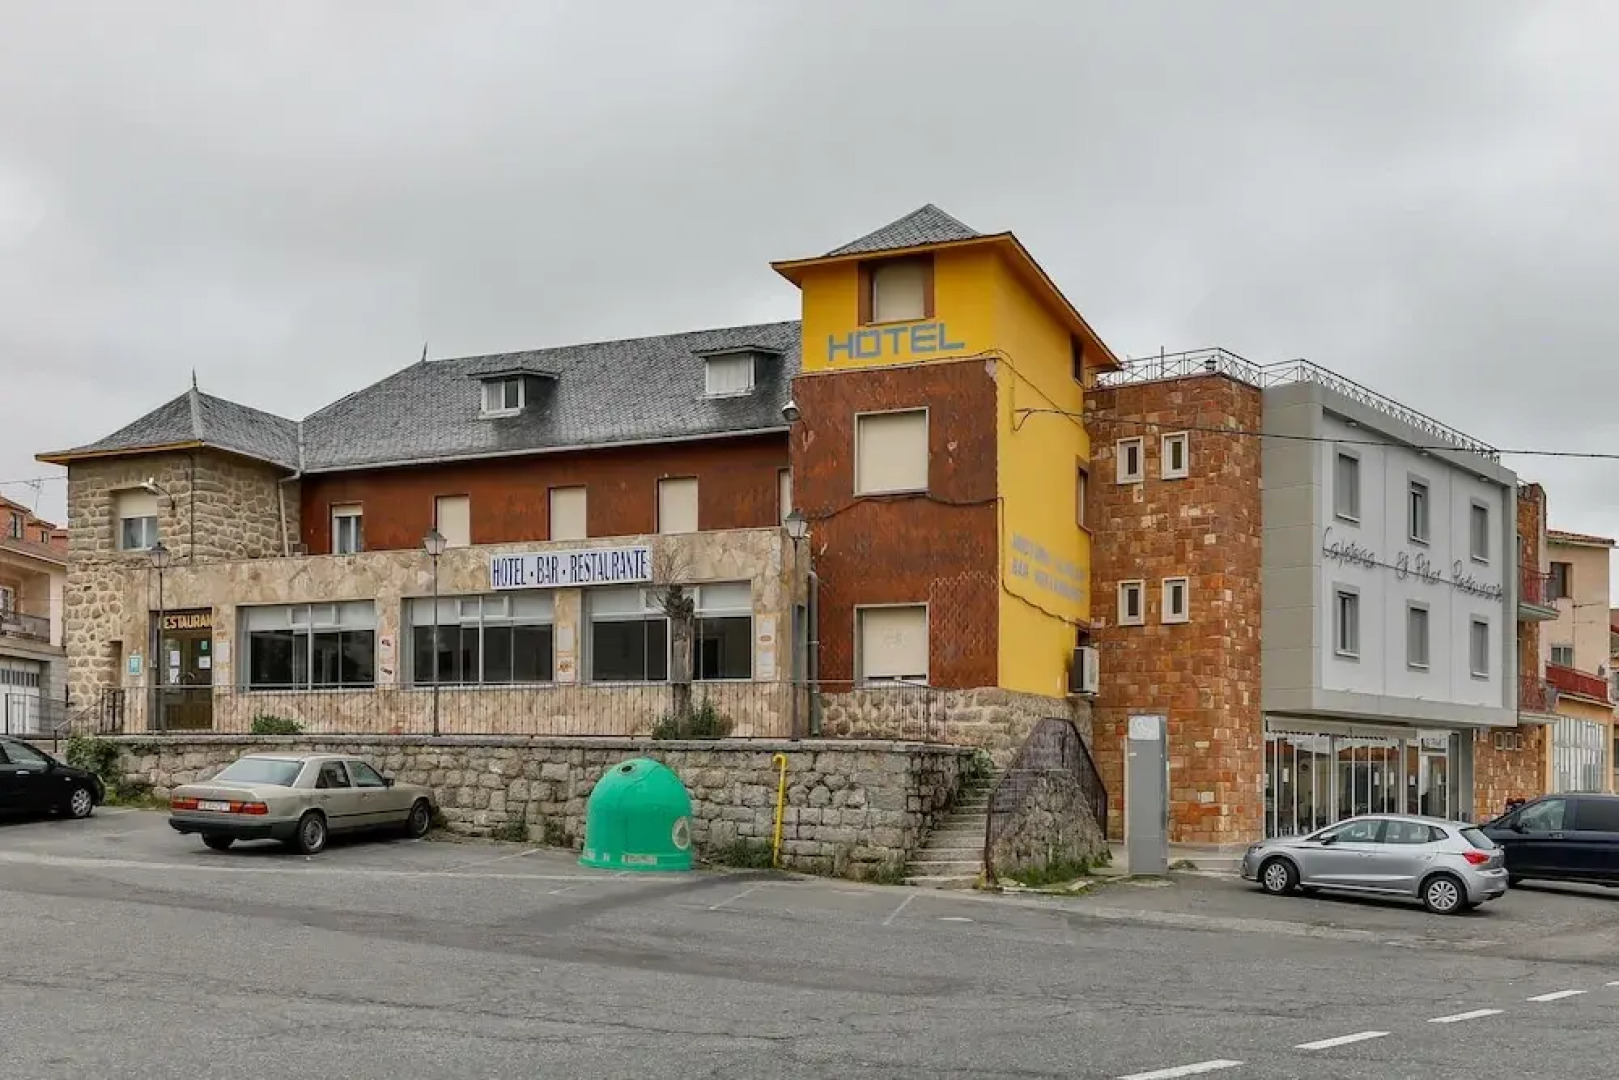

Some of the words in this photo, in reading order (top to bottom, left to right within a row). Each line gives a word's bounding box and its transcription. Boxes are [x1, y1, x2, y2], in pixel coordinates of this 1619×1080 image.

[828, 322, 965, 362] HOTEL
[493, 558, 527, 587] HOTEL
[537, 556, 559, 584] BAR
[570, 550, 647, 583] RESTAURANTE
